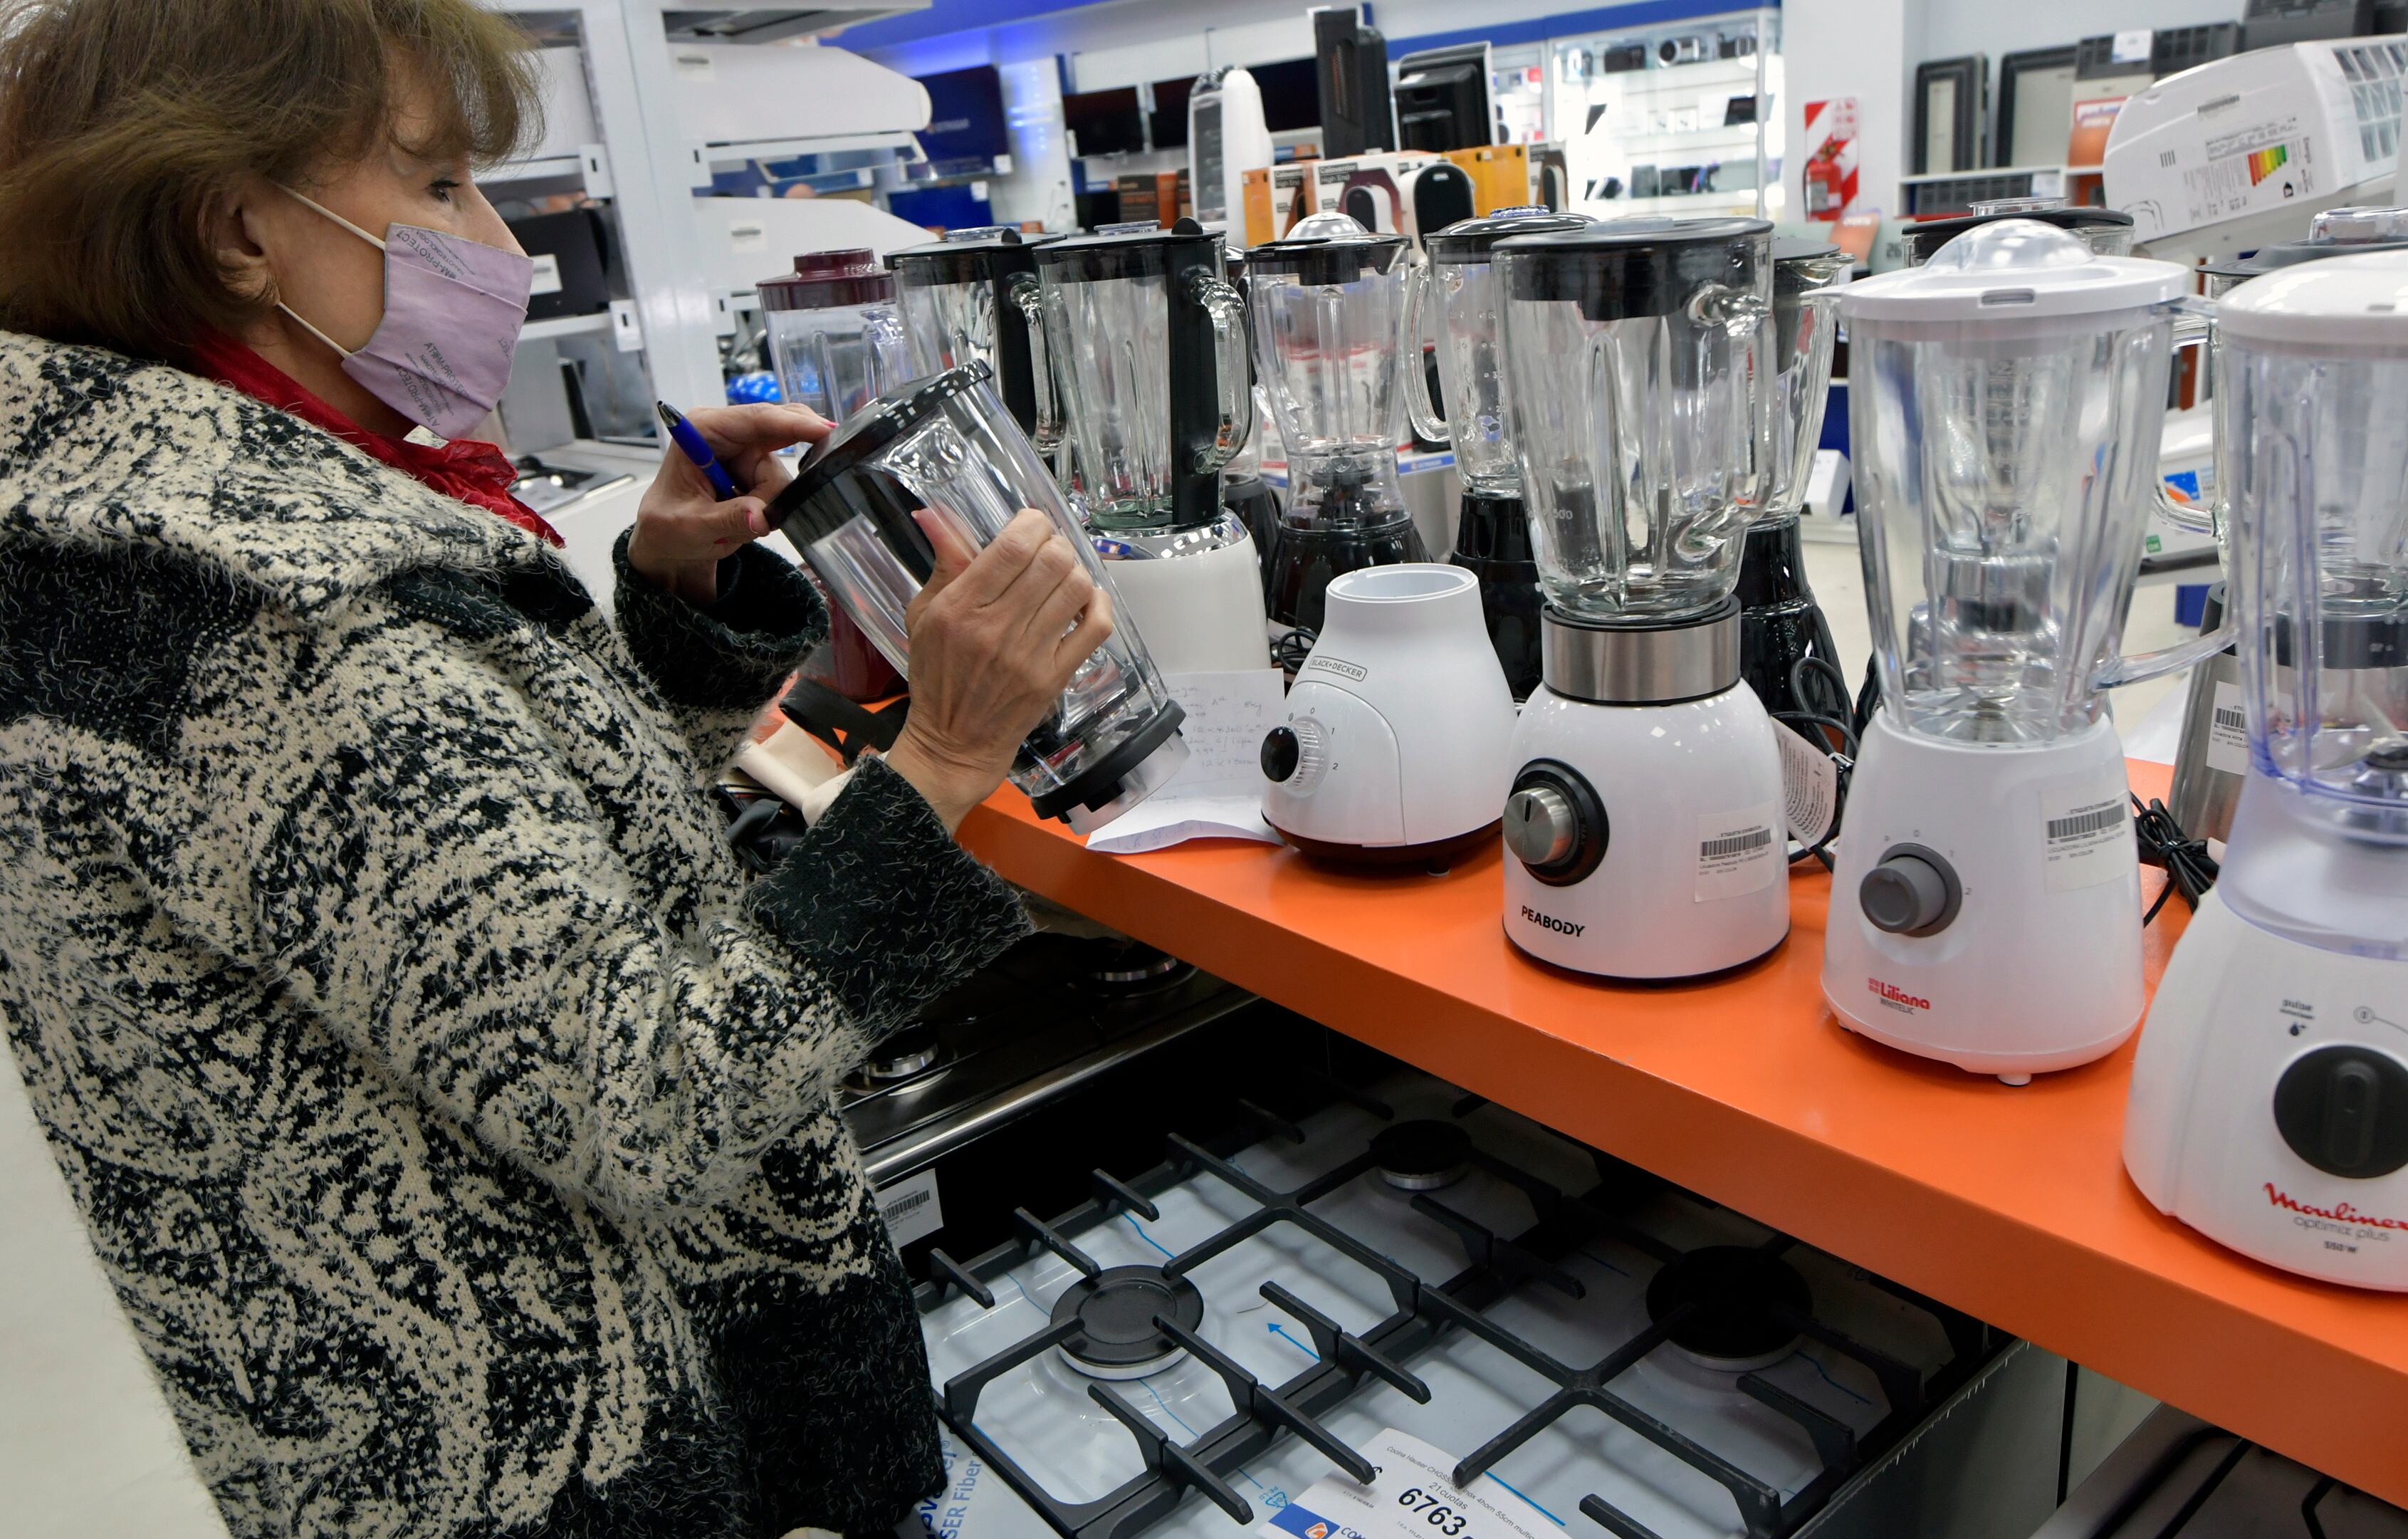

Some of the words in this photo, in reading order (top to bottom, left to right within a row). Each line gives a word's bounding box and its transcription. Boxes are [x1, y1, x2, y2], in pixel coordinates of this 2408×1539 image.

[1311, 659, 1363, 678] BLACK+DECKER
[1332, 762, 1339, 771] 2
[1521, 905, 1586, 937] PEABODY
[1881, 982, 1930, 1010] Liliana
[2355, 1228, 2391, 1242] plus
[952, 1460, 983, 1501] Fiber
[1386, 1446, 1406, 1458] Cocina
[1406, 1455, 1428, 1468] Hauser
[1495, 1511, 1514, 1525] 55cm
[1398, 1488, 1475, 1539] 6763
